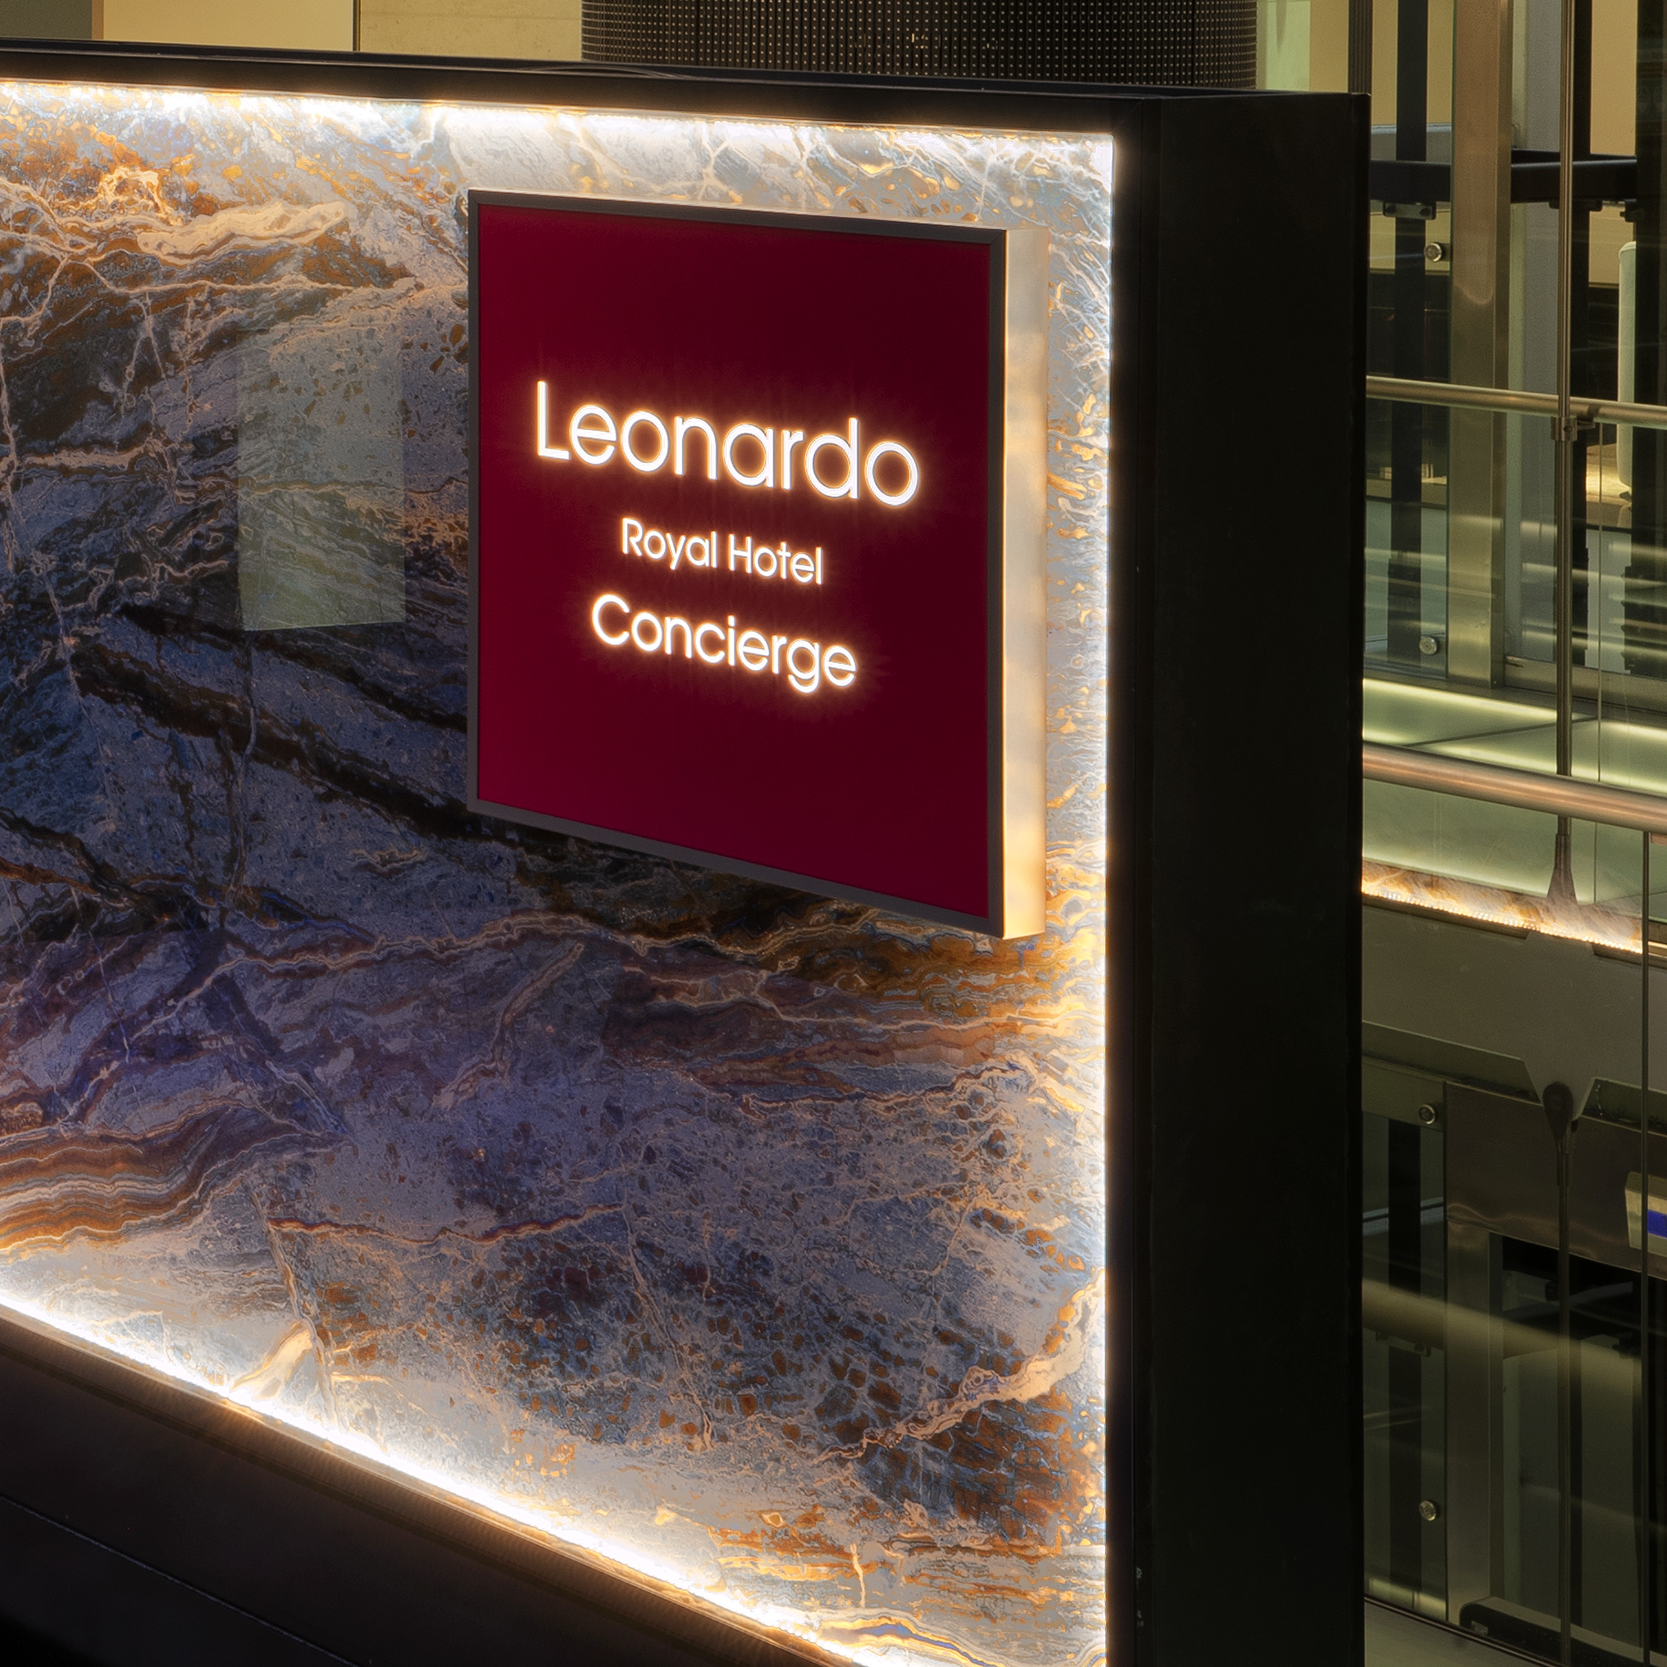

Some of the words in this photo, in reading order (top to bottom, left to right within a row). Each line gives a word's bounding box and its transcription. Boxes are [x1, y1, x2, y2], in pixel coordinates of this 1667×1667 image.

[536, 380, 919, 506] Leonardo
[622, 518, 717, 570] Royal
[728, 534, 823, 585] Hotel
[592, 594, 857, 694] Concierge
